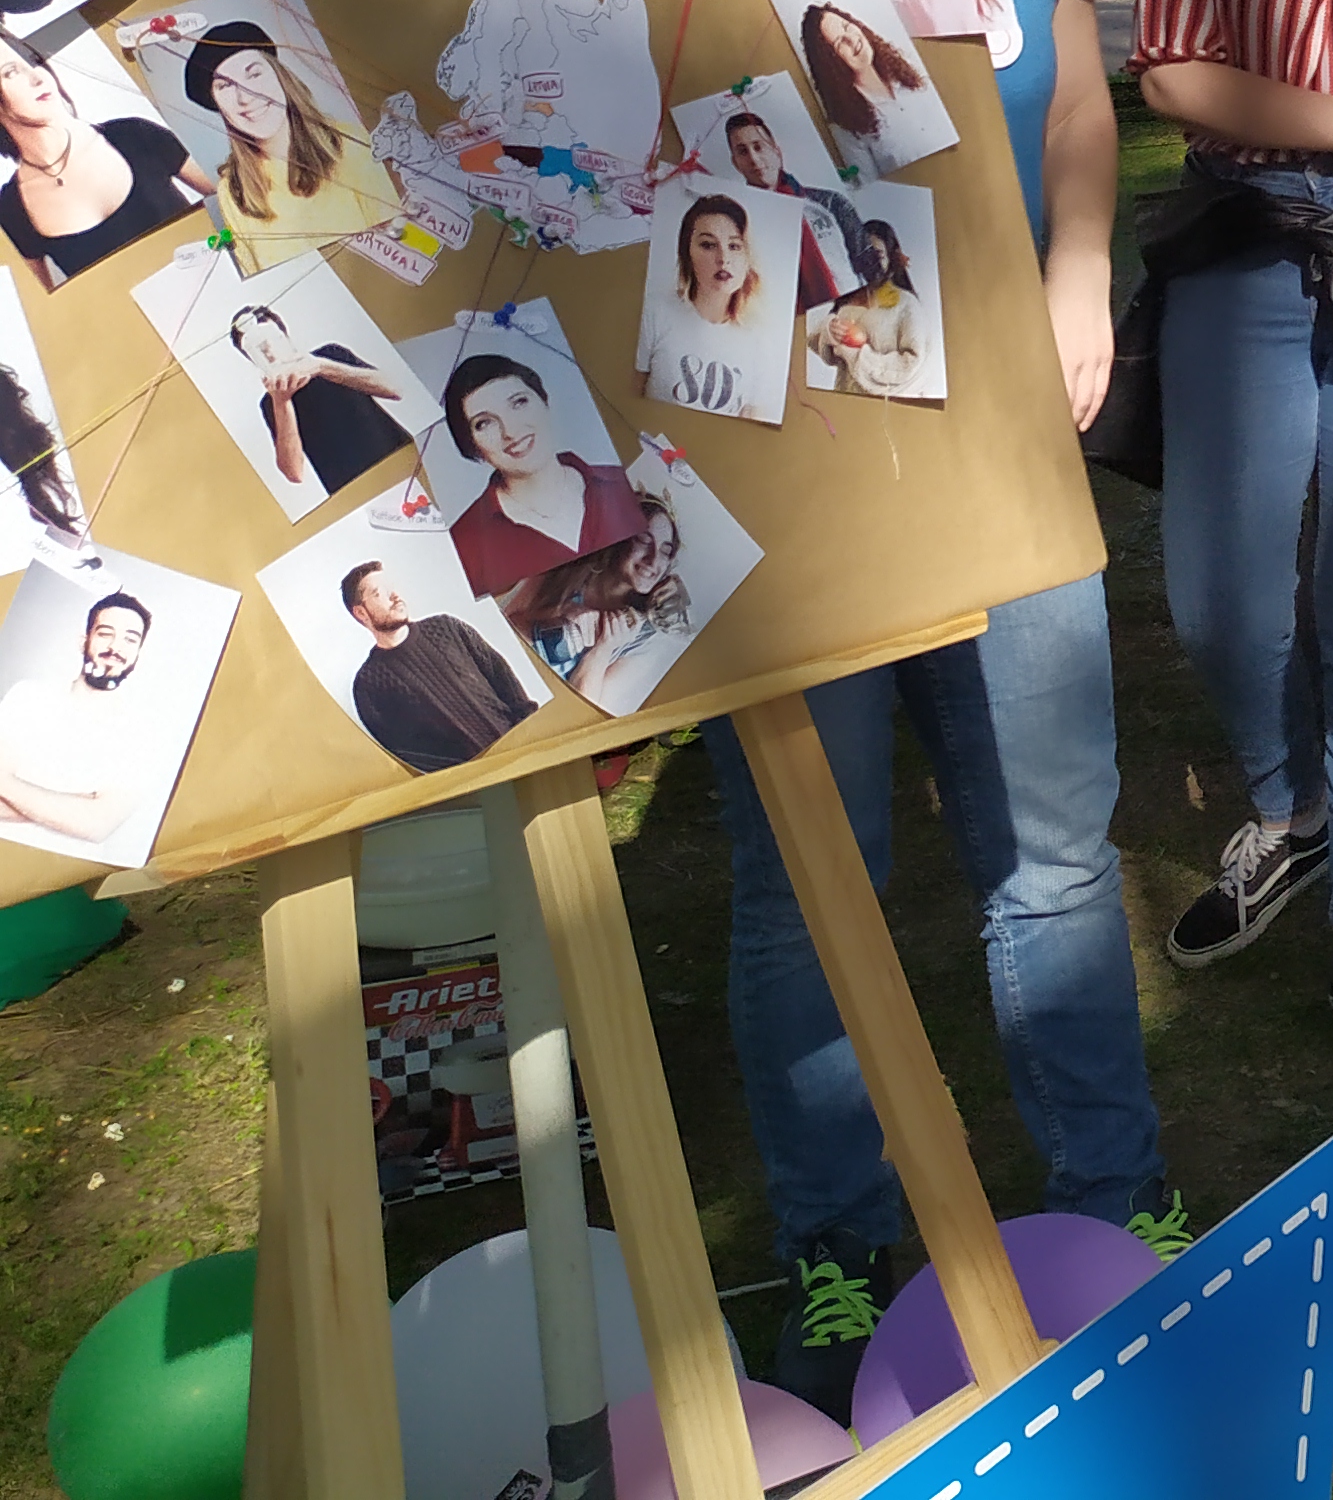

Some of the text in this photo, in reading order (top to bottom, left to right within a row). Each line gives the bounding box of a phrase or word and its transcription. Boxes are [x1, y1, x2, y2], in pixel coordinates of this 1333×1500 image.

[623, 185, 653, 204] GEORG
[416, 202, 462, 236] PAIN
[355, 232, 420, 273] ORTUGAL
[377, 977, 497, 1015] Ariet
